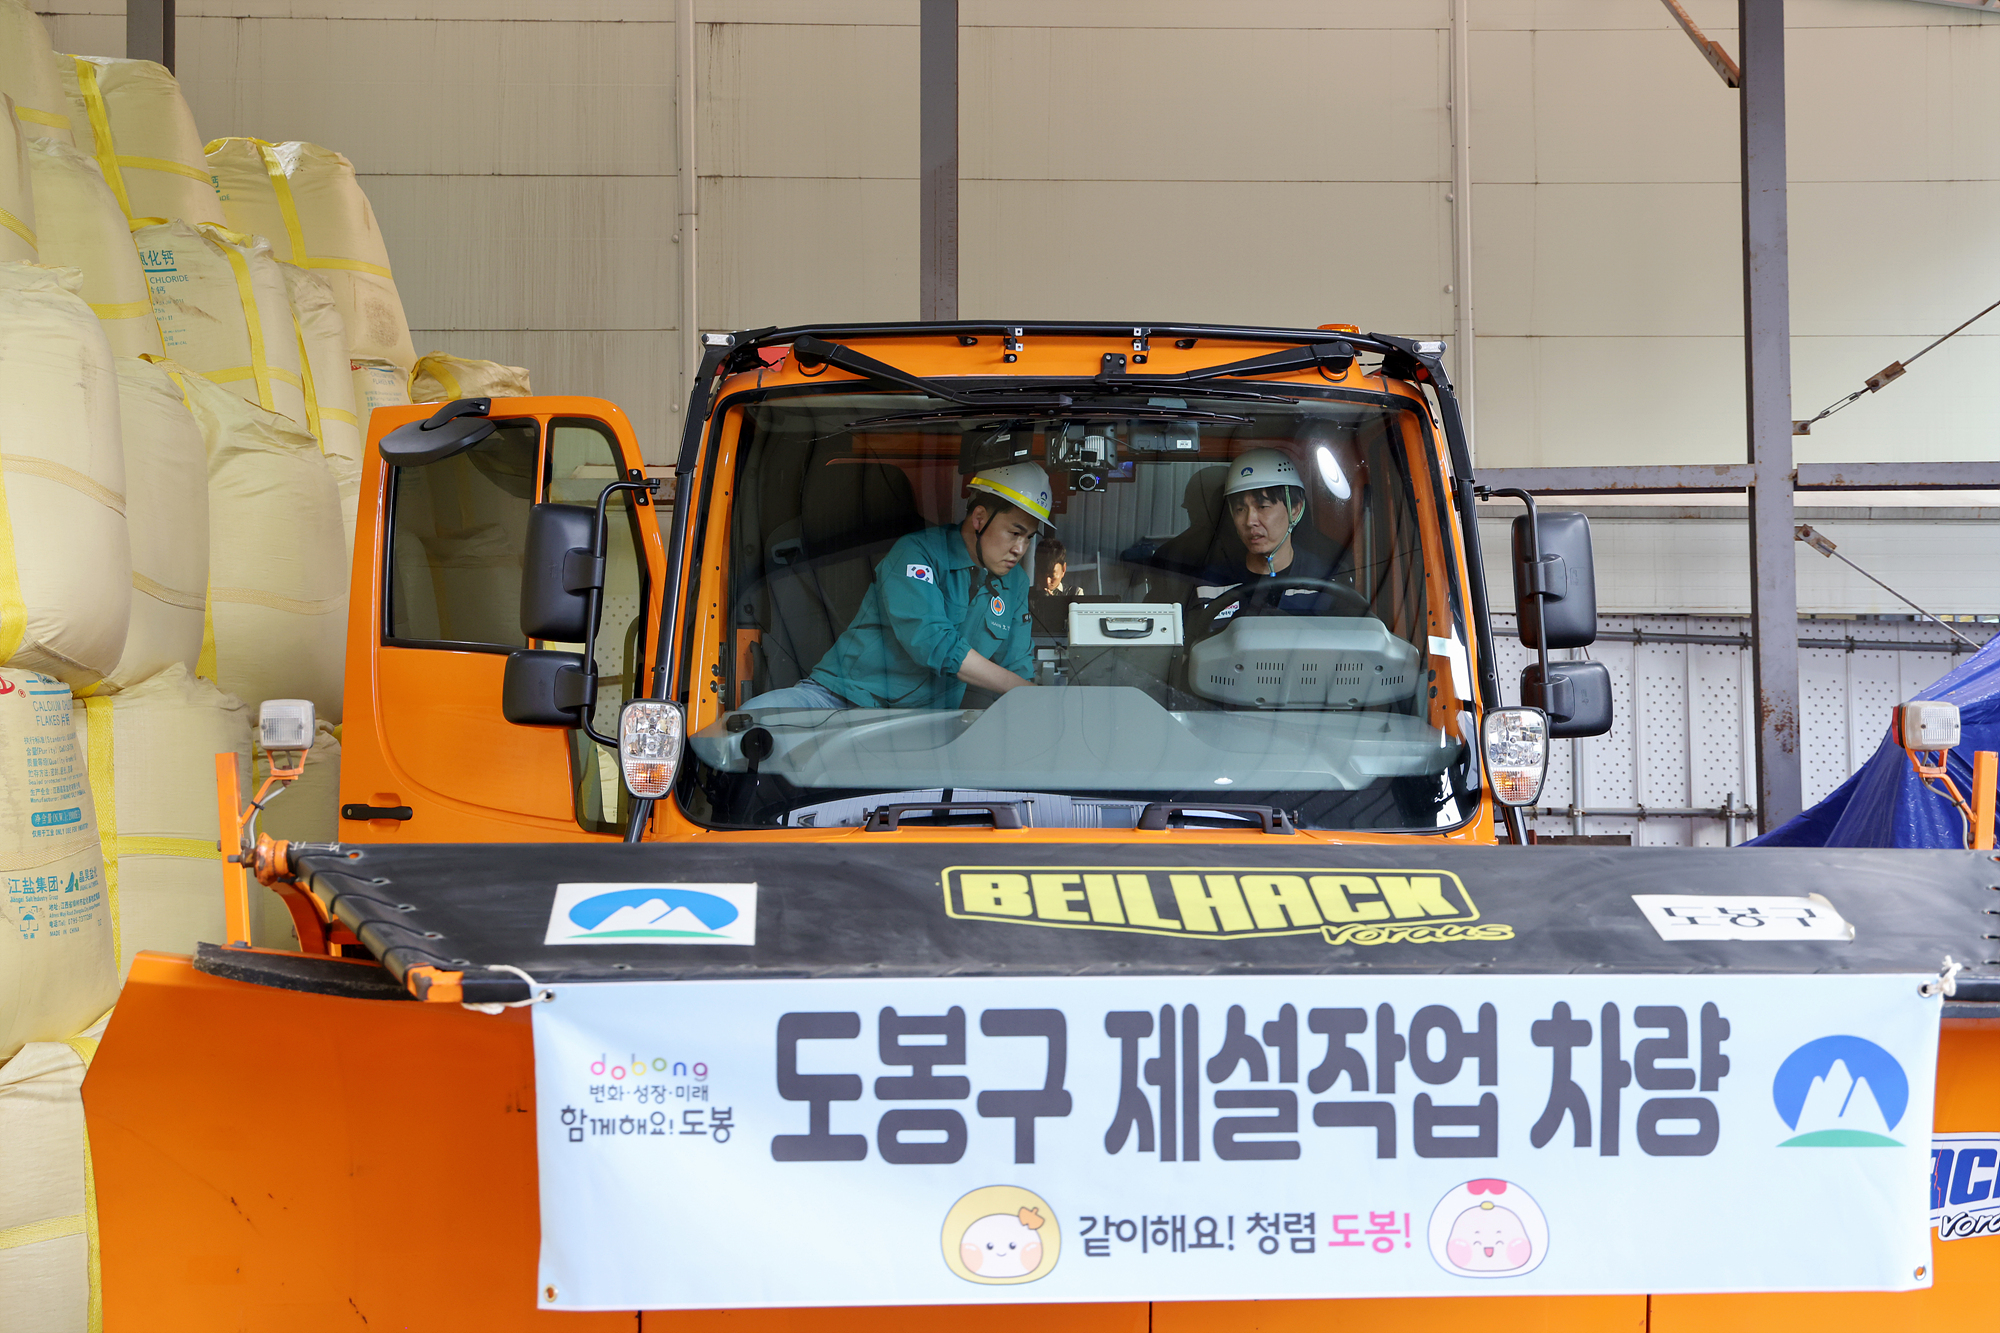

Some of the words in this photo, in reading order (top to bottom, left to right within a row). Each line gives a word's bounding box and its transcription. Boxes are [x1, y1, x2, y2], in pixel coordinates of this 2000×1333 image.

[150, 275, 189, 285] CHLORIDE
[33, 700, 61, 712] CALCIUM
[36, 714, 60, 727] FLAKES
[960, 874, 1460, 932] BEILHACK
[590, 1053, 708, 1082] dobong
[589, 1084, 709, 1105] 변화·성장·미래
[770, 1005, 1073, 1164] 도봉구
[1103, 1001, 1499, 1161] 제설작업
[1530, 1001, 1731, 1157] 차량
[560, 1105, 674, 1143] 함께해요!
[678, 1106, 735, 1144] 도봉
[1079, 1213, 1235, 1257] 같이해요!
[1246, 1212, 1316, 1255] 청렴
[1327, 1211, 1411, 1254] 도봉!
